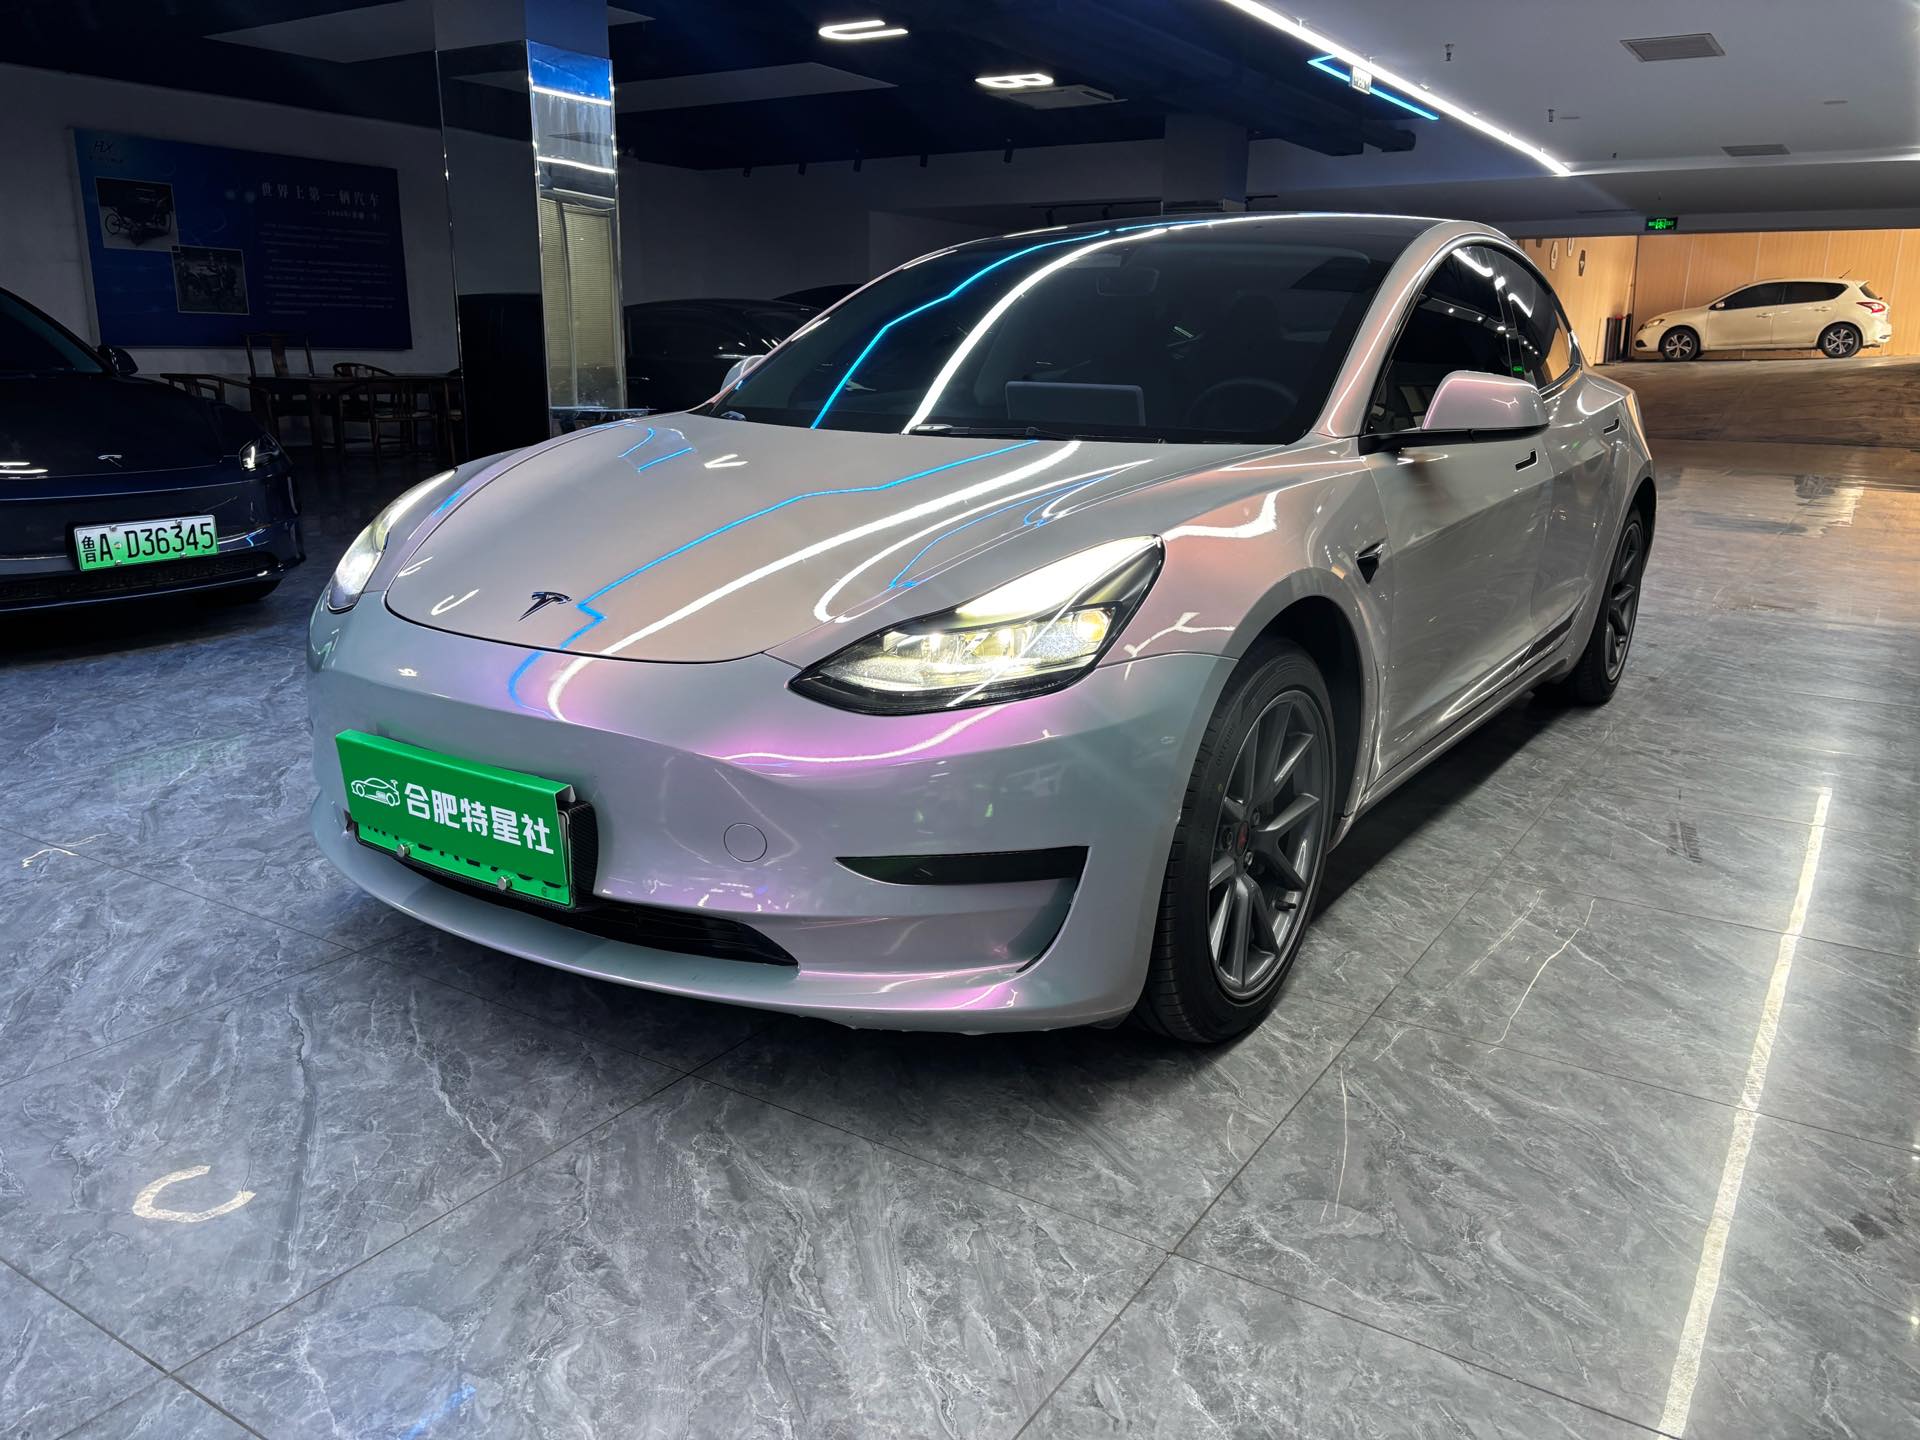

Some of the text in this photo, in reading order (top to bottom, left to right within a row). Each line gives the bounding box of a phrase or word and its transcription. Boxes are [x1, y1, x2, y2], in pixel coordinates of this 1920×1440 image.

[404, 782, 555, 855] 合肥特星社
